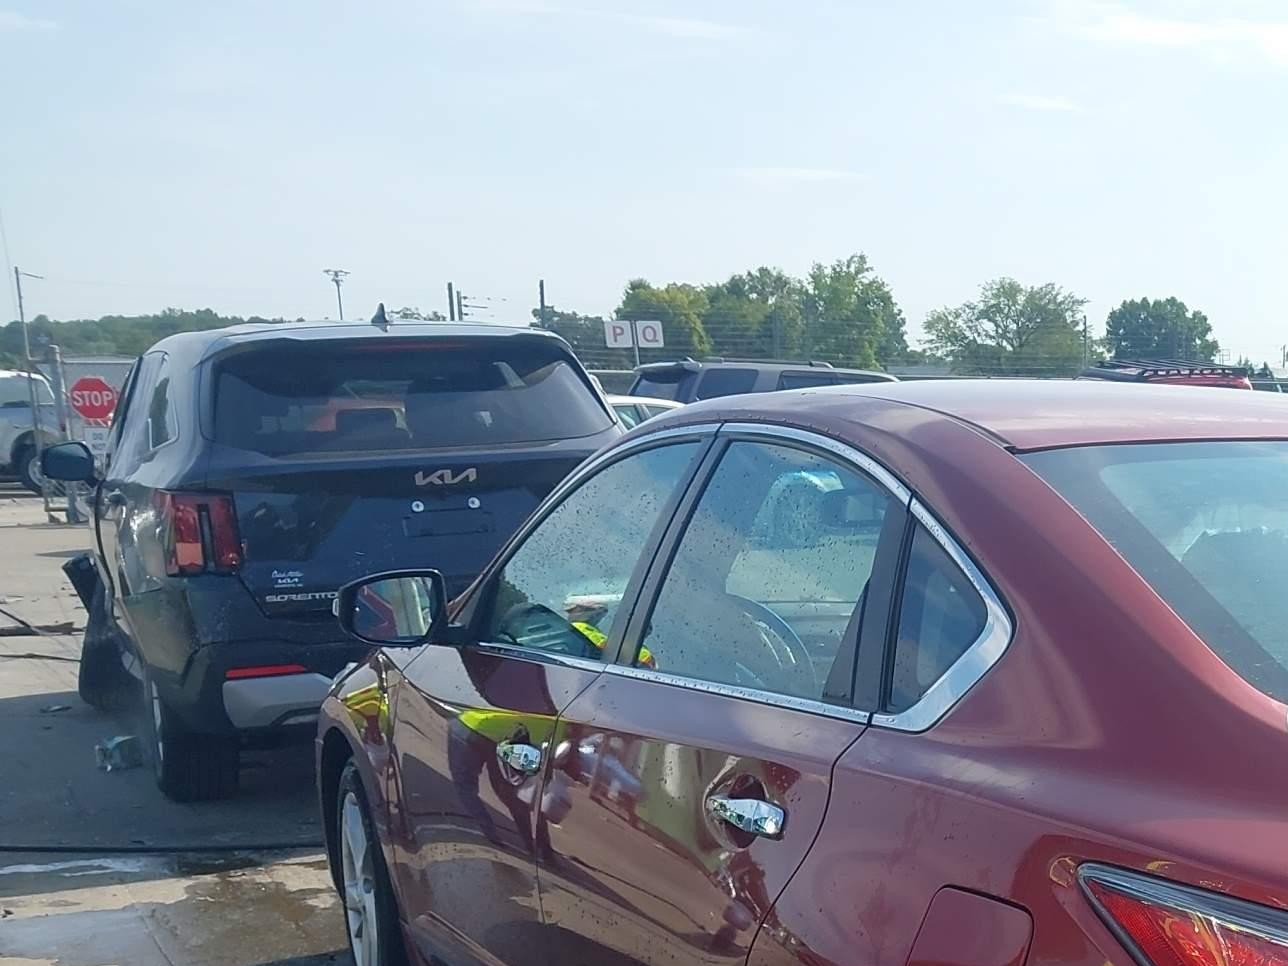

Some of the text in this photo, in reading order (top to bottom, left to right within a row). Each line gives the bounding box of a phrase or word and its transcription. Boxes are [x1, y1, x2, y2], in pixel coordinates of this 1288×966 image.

[612, 325, 625, 343] P
[642, 325, 660, 343] Q
[72, 390, 113, 406] STOP
[415, 468, 477, 485] KIA
